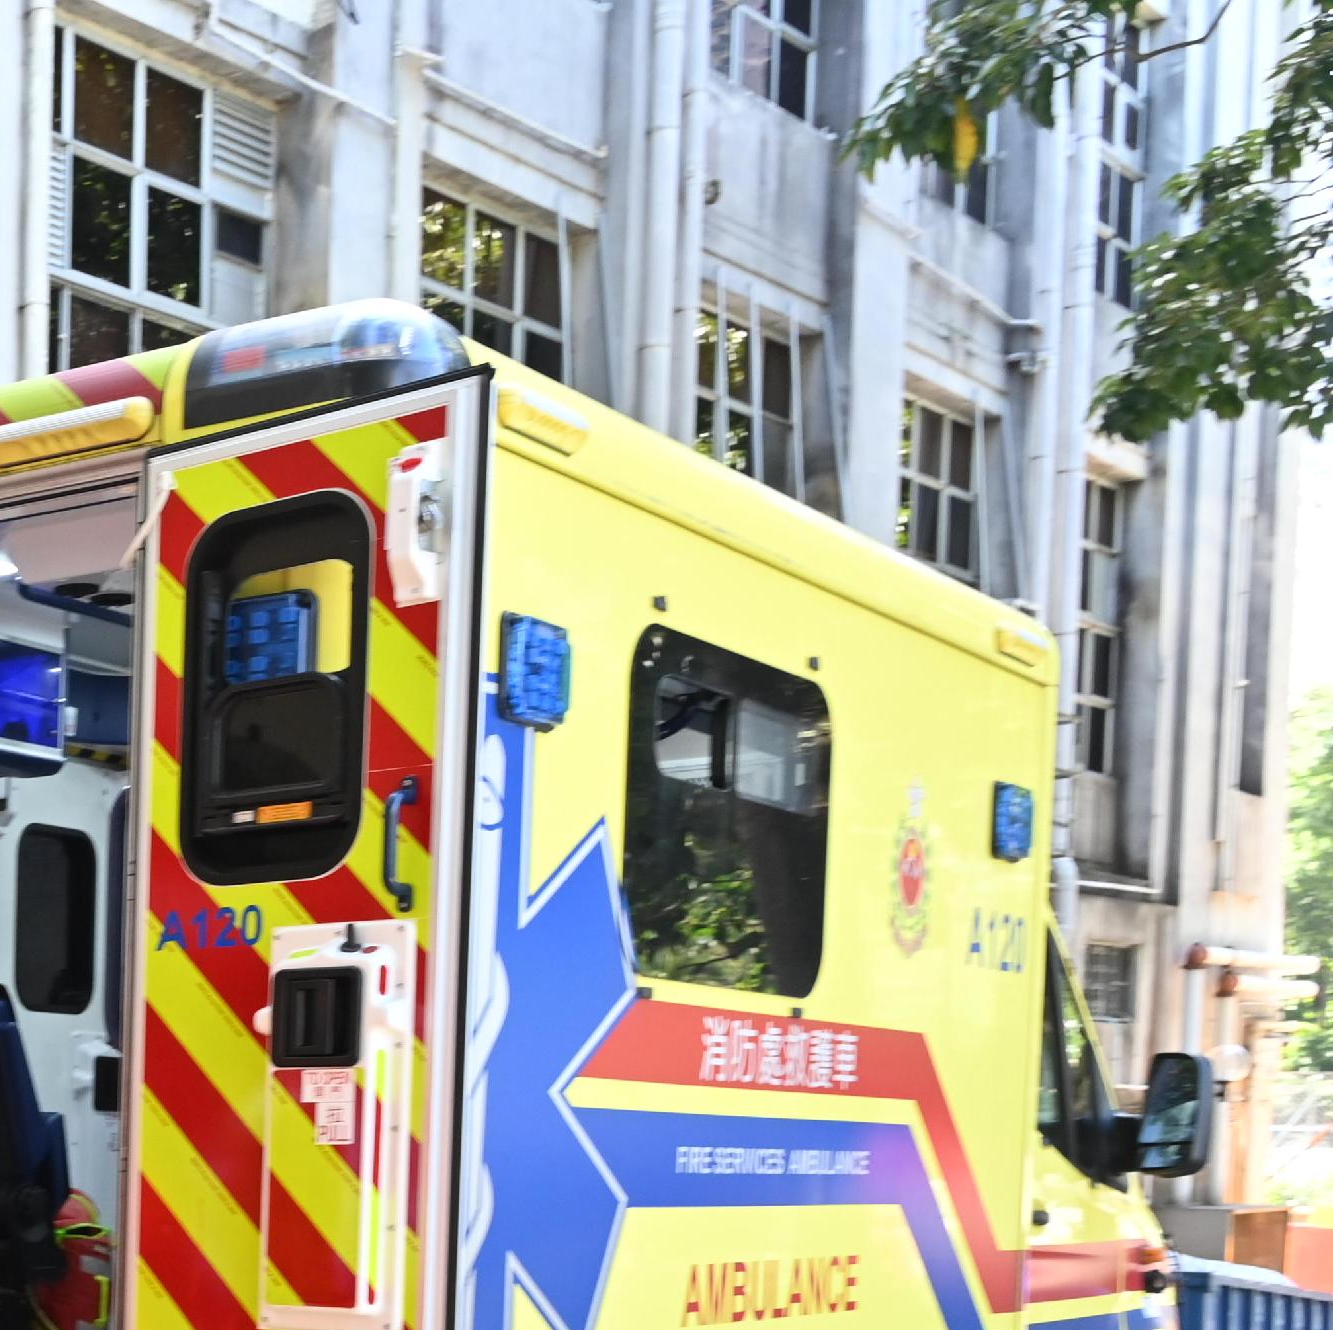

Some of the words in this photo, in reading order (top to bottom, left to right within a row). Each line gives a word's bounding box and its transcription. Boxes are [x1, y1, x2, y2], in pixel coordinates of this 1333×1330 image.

[156, 904, 262, 951] A120
[964, 906, 1028, 974] A120
[699, 1015, 860, 1091] 消防處救護車
[675, 1146, 714, 1174] FIRE
[714, 1146, 786, 1175] SERVICES
[786, 1149, 871, 1175] AMBULANCE
[679, 1255, 861, 1328] AMBULANCE
